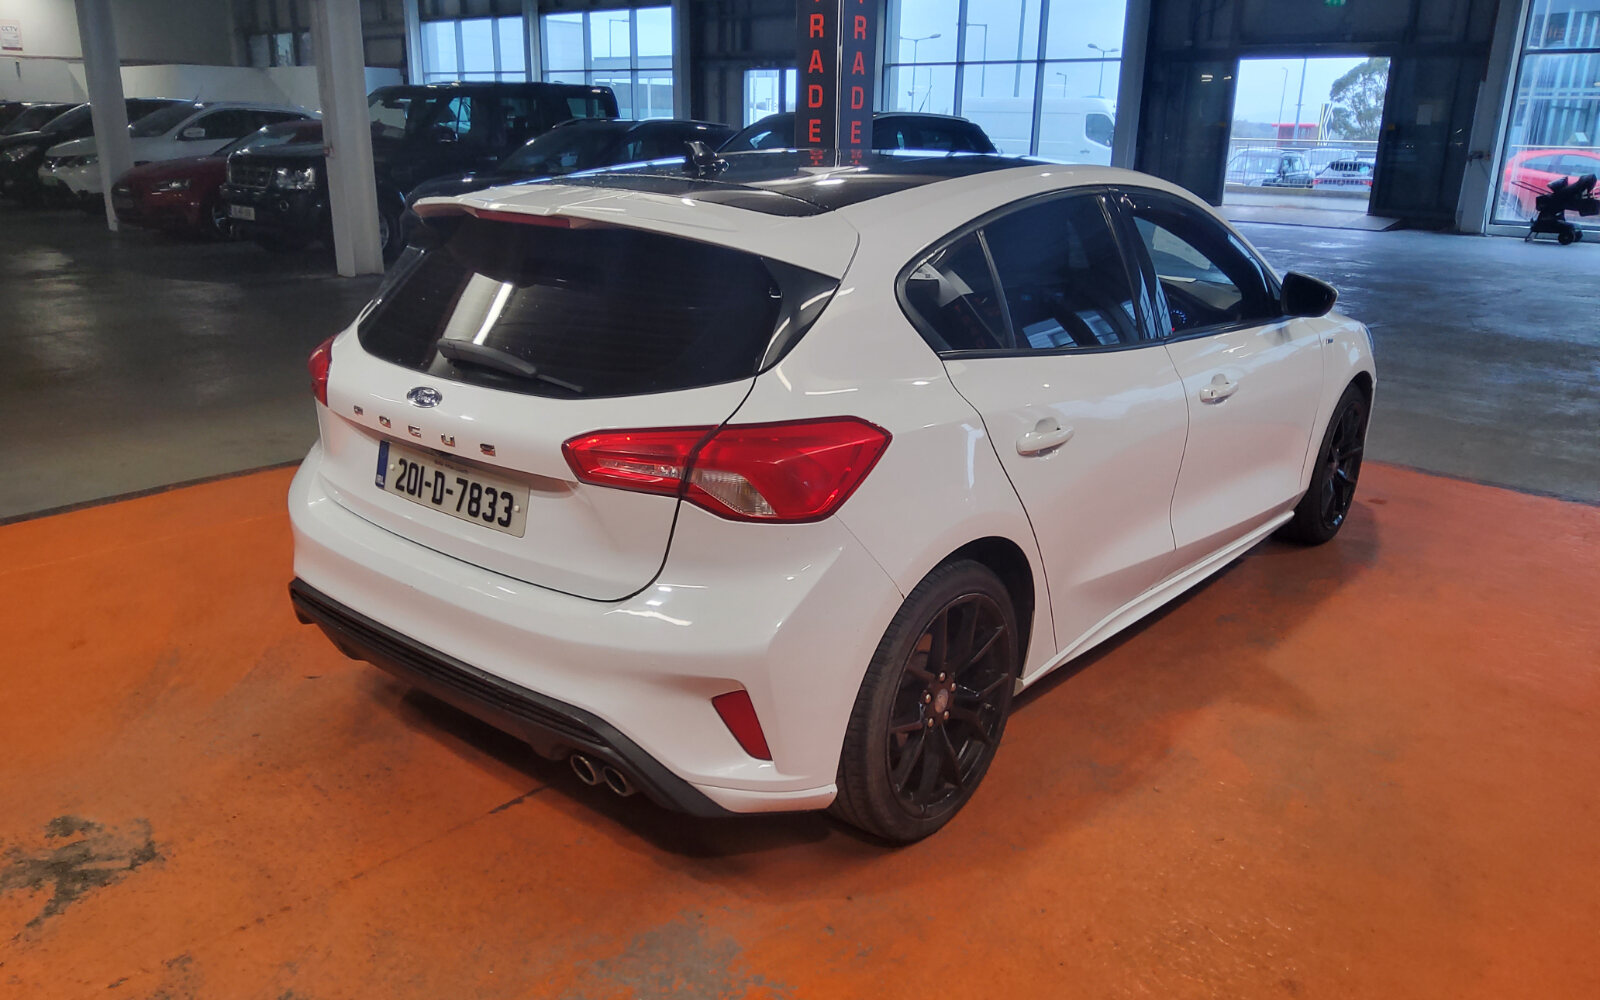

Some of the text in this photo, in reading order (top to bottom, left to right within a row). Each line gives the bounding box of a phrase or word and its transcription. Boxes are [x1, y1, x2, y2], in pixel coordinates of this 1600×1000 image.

[808, 0, 825, 143] RADE
[851, 0, 867, 144] RADE
[353, 404, 496, 457] FOCUS
[395, 457, 514, 528] 201-D-7833
